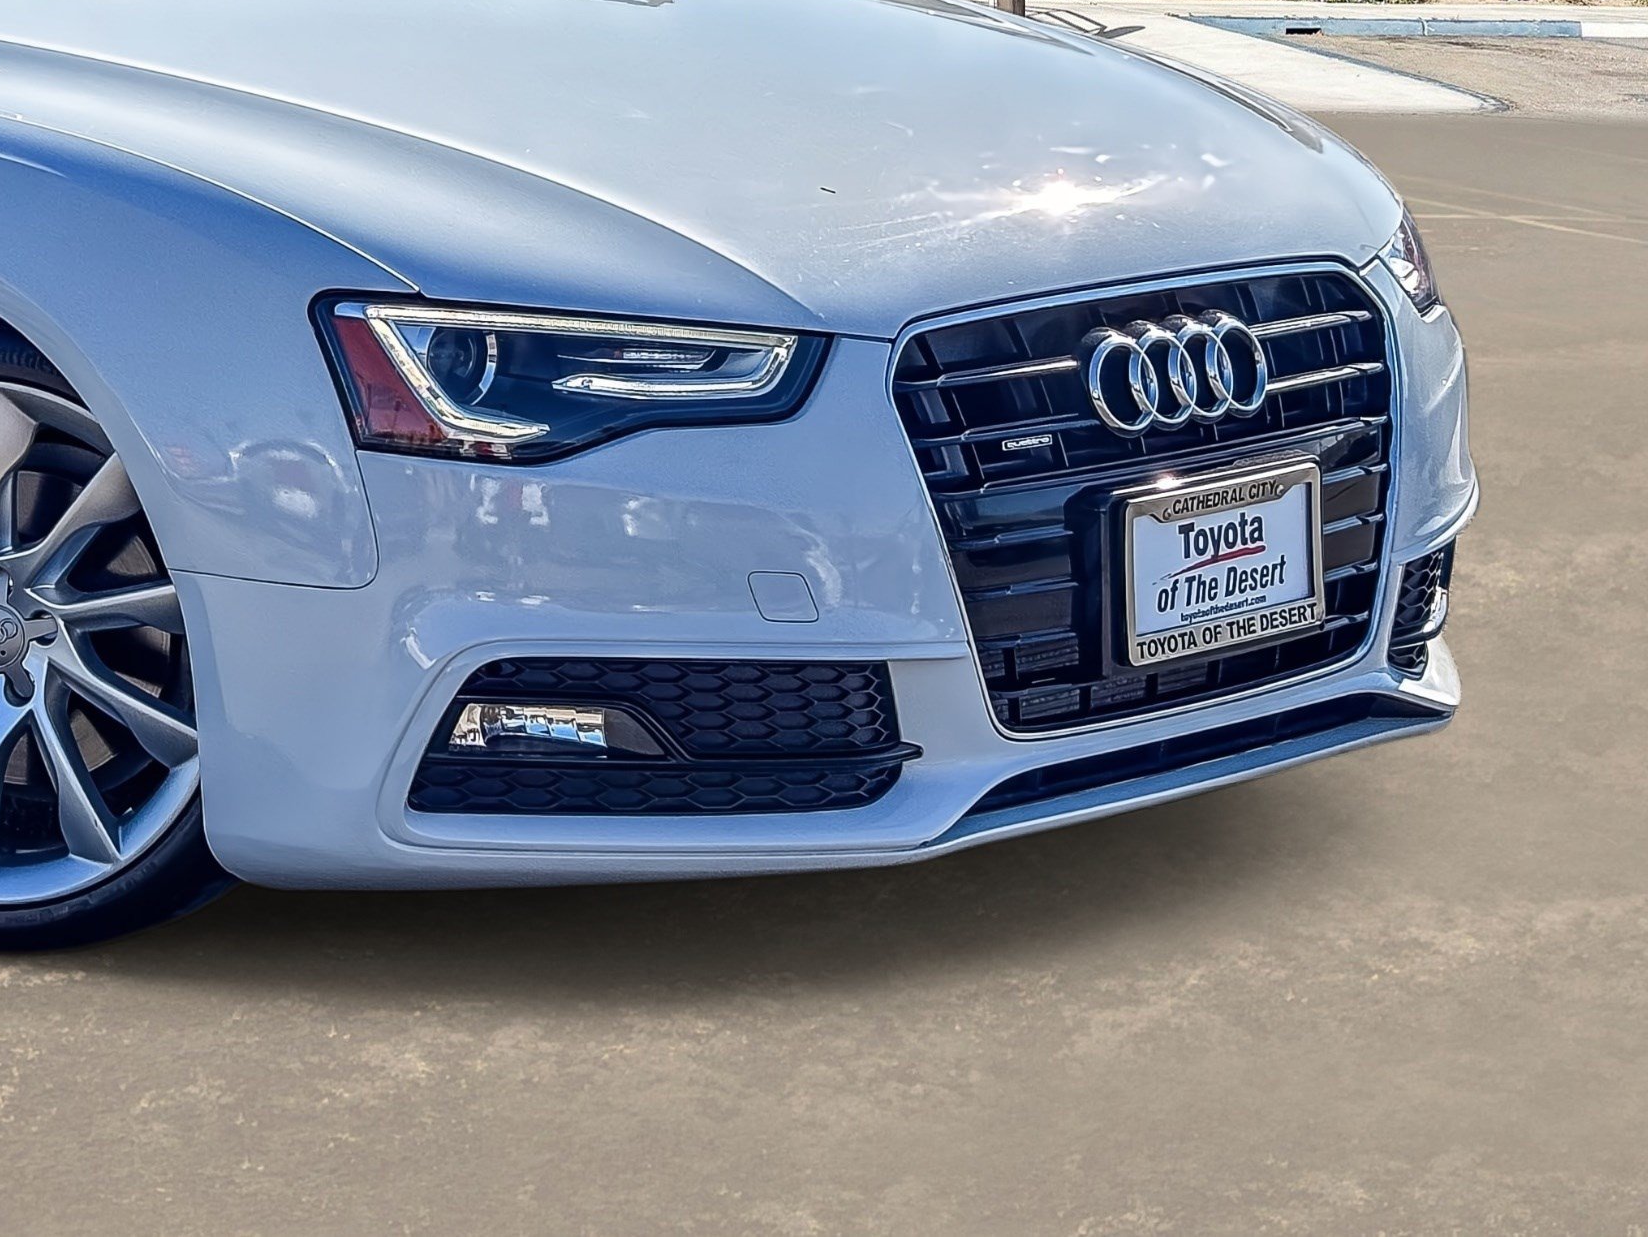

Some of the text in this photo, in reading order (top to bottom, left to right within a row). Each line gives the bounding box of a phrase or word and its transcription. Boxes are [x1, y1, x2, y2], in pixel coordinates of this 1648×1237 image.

[1172, 479, 1277, 515] CATHEDRAL CITY
[1177, 512, 1265, 561] Toyota
[1156, 554, 1287, 613] of The Desert
[1136, 602, 1318, 659] TOYOTA OF THE DESERT
